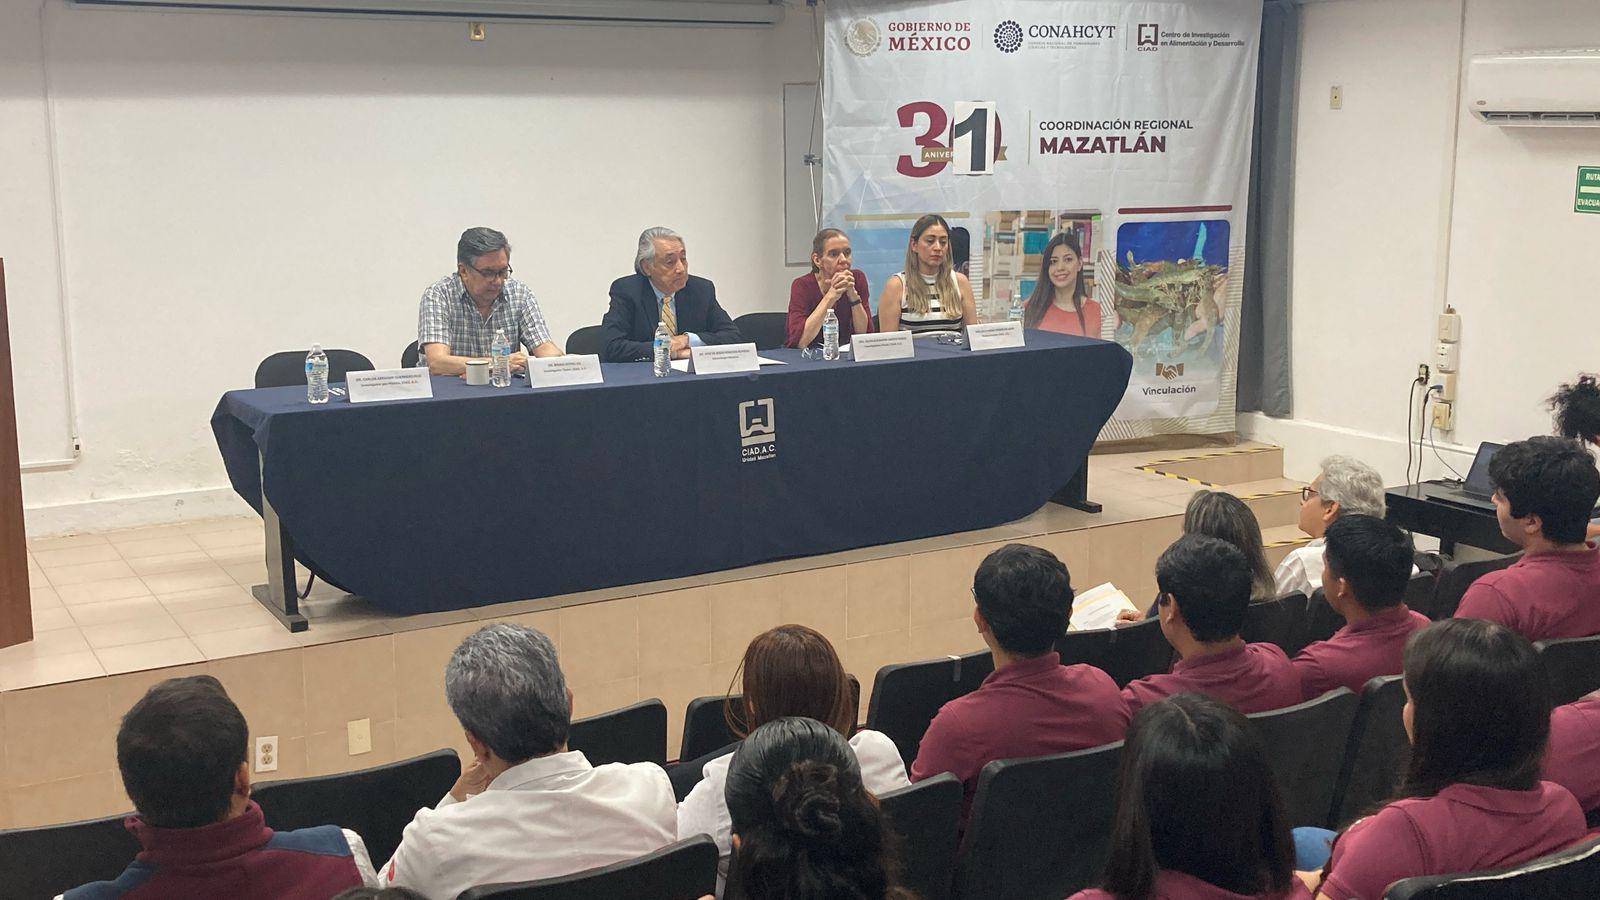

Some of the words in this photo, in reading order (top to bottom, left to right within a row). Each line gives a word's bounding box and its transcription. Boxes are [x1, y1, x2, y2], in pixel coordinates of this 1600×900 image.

[888, 22, 952, 33] GOBIERNO
[954, 22, 971, 32] DE
[1028, 25, 1116, 39] CONAHCYT
[1191, 31, 1230, 39] Investigación
[888, 33, 971, 52] MÉXICO
[1039, 118, 1131, 131] COORDINACIÓN
[1134, 119, 1193, 130] REGIONAL
[1039, 131, 1166, 155] MAZATLÁN
[1142, 385, 1196, 396] Vinculación
